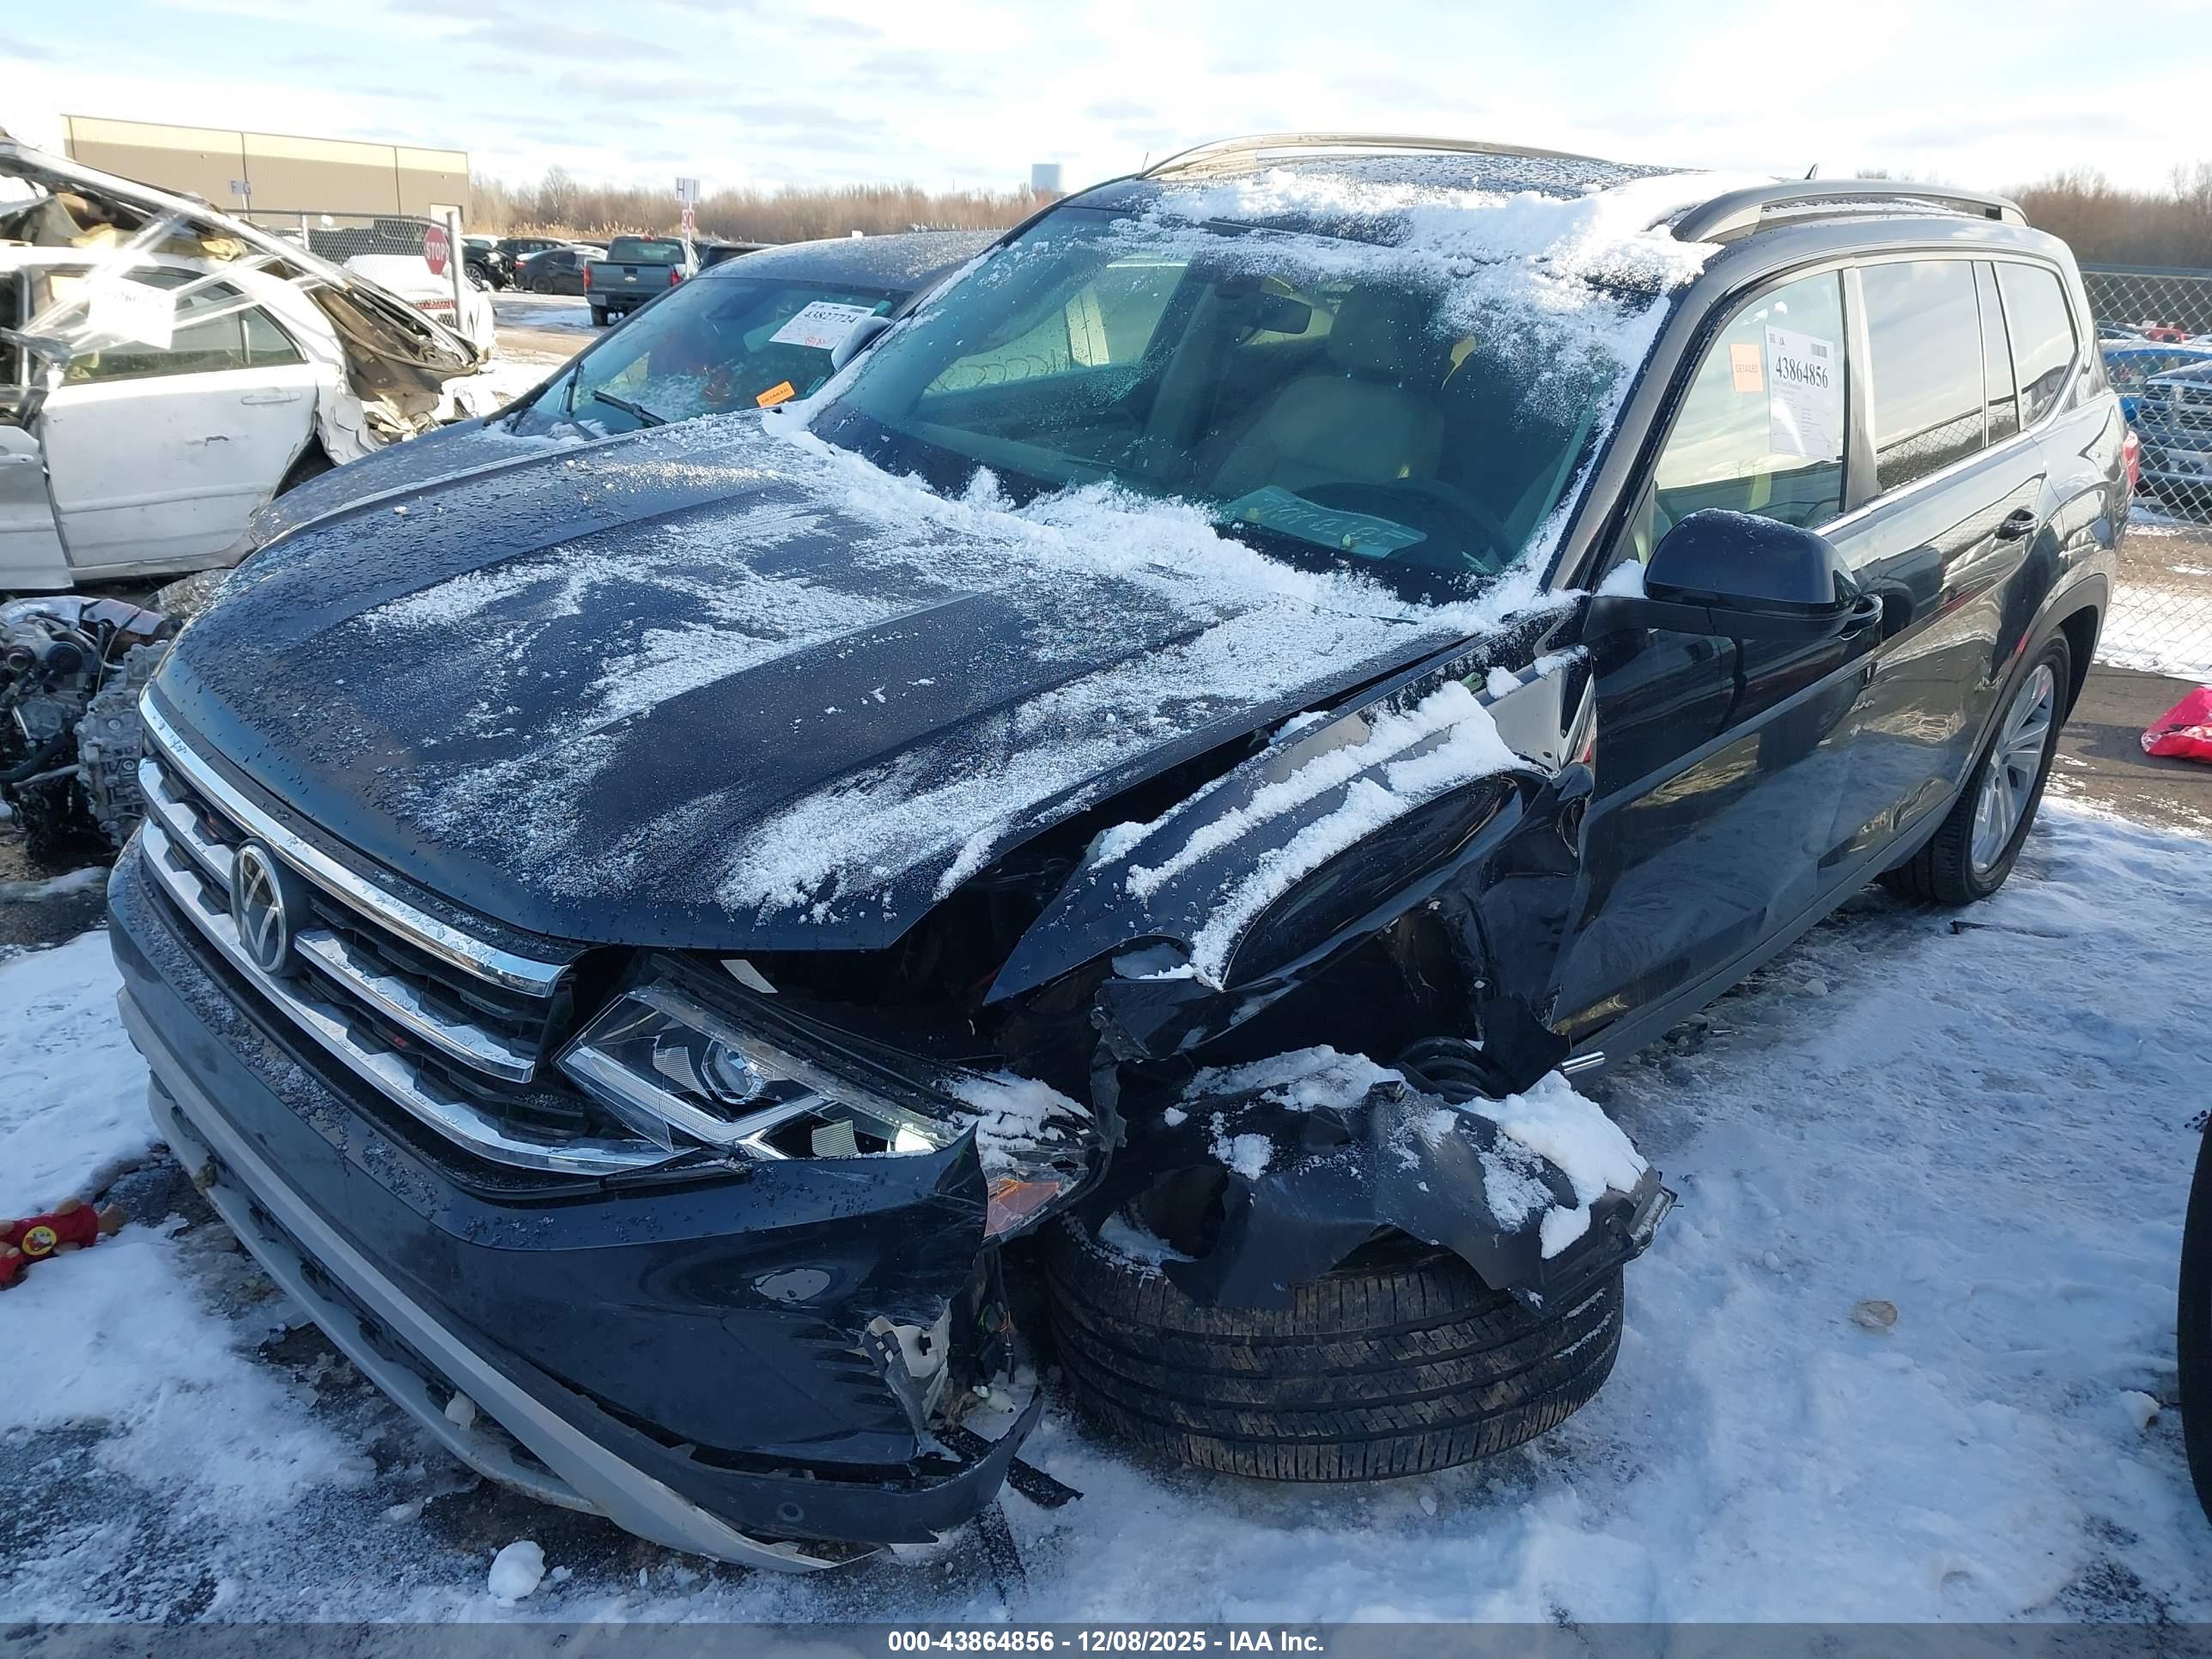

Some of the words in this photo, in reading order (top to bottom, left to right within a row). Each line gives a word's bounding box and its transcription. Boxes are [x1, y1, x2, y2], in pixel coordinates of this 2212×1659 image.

[676, 178, 685, 200] H
[682, 211, 694, 231] 90
[426, 240, 446, 261] STOP
[804, 311, 859, 324] 43827724
[1735, 363, 1759, 373] DETAILED
[1775, 355, 1828, 389] 43864856
